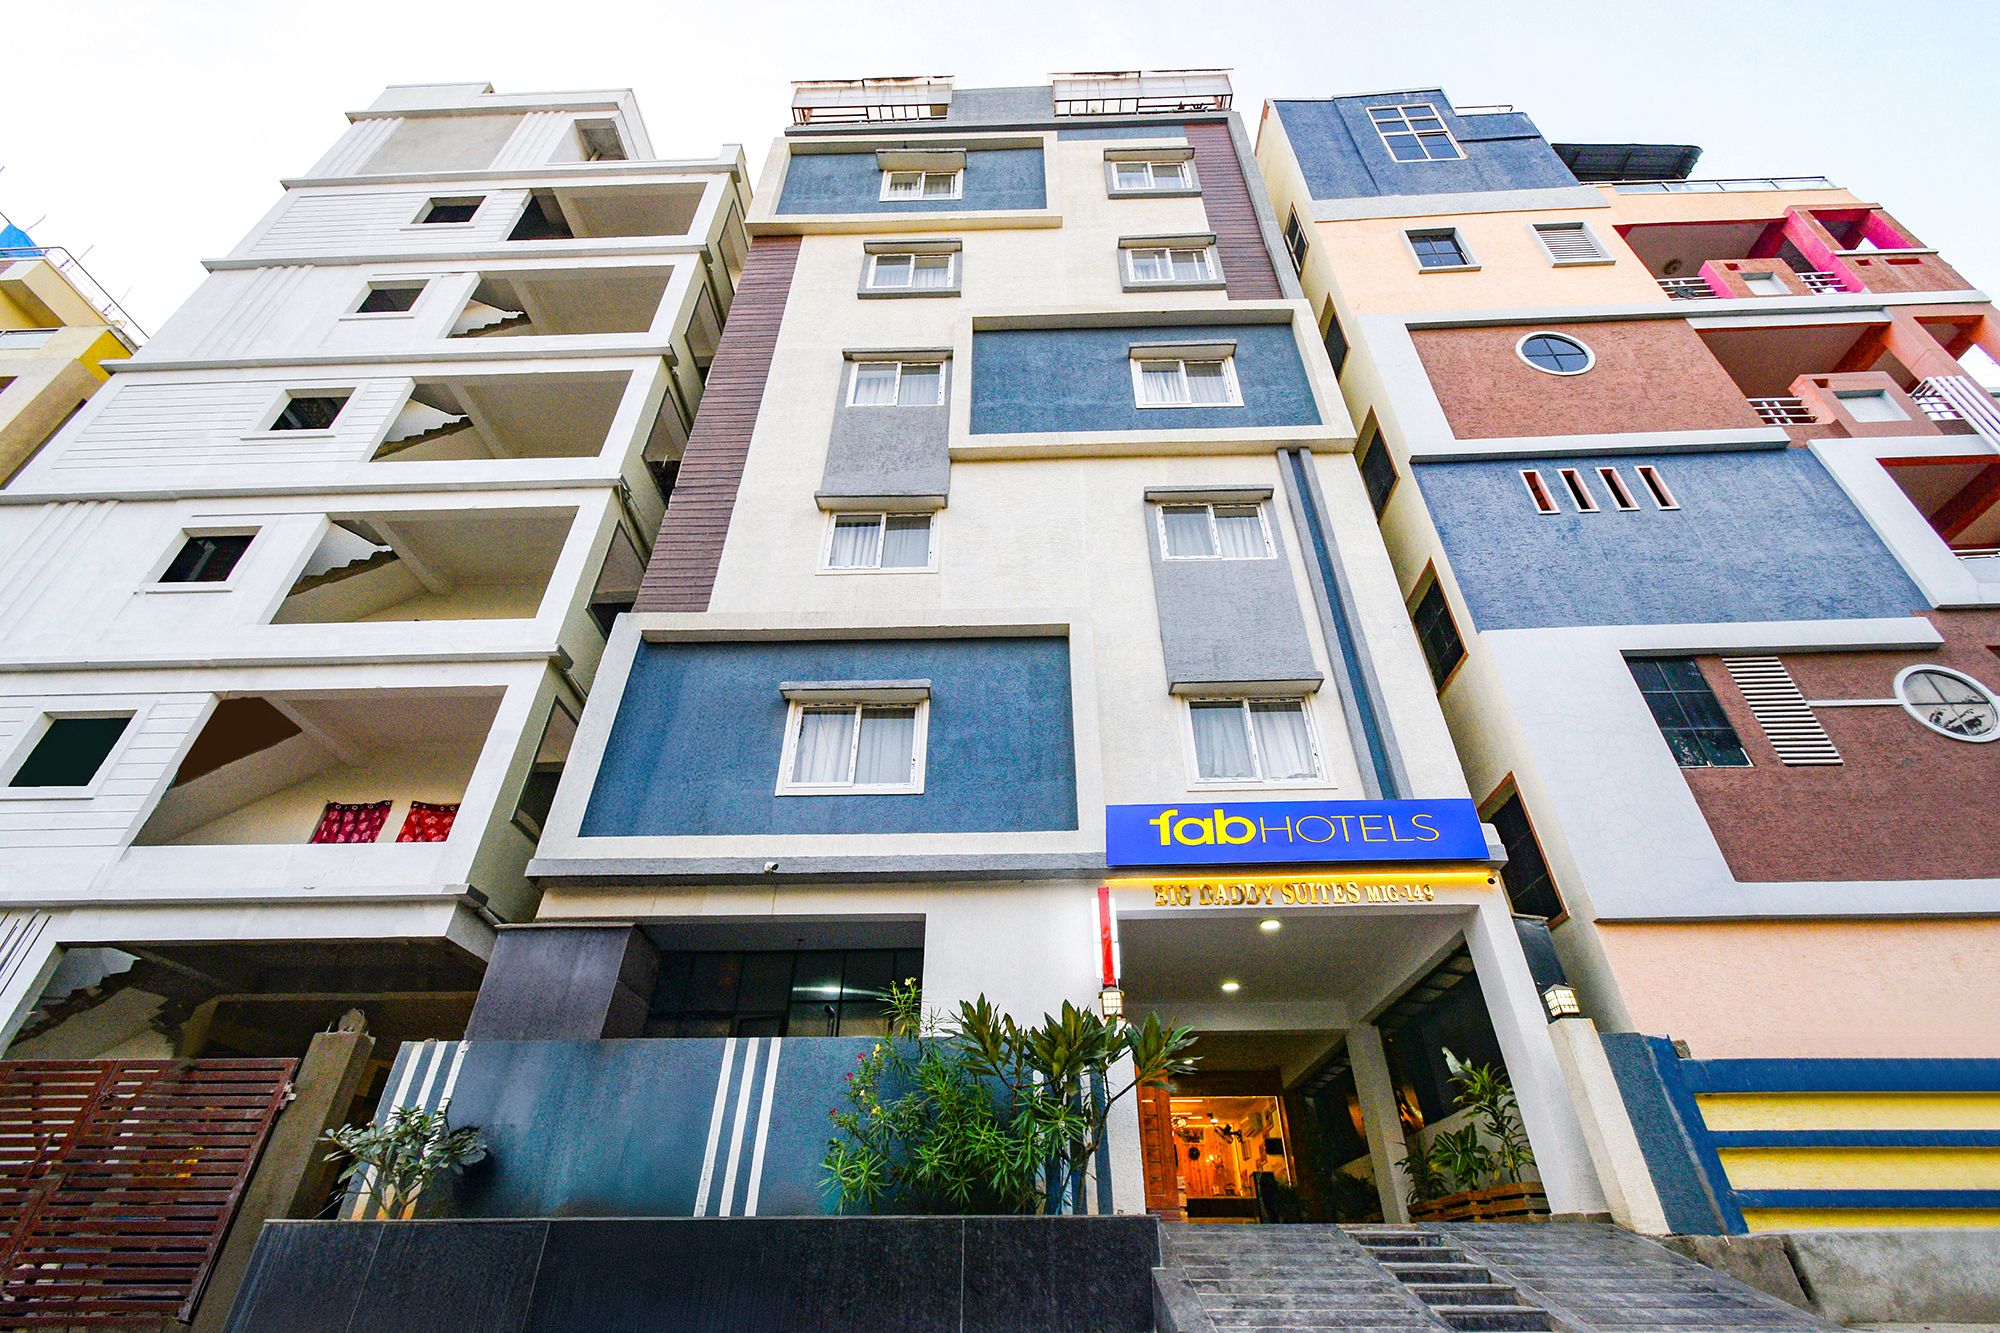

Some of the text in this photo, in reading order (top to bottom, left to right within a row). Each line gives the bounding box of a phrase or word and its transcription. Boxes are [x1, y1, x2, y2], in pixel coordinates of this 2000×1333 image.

[1153, 881, 1435, 906] BIG DADDY SUITES MIG-149
